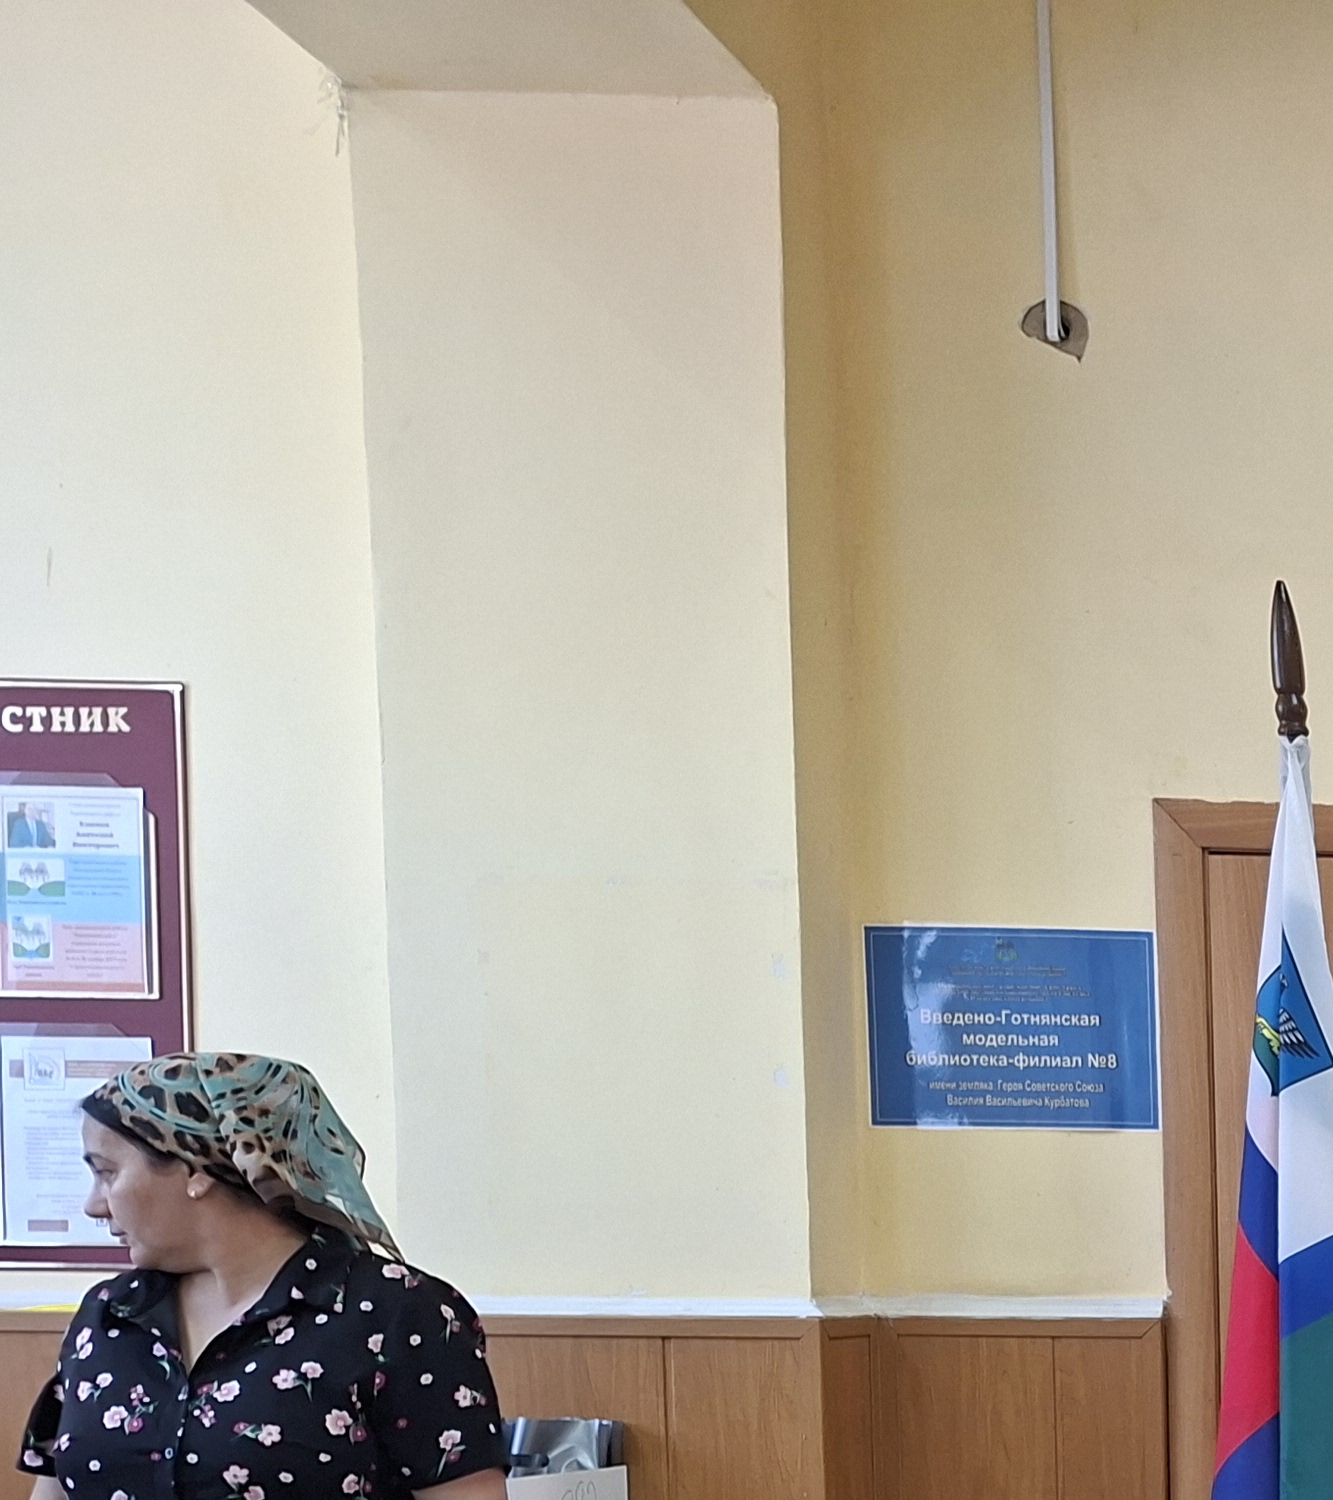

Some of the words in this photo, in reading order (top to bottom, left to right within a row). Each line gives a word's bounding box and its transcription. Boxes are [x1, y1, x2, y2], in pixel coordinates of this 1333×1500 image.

[919, 1008, 1101, 1028] Введено-Готнянская
[962, 1034, 1060, 1048] модельная
[905, 1052, 1083, 1069] библиотека-филиал
[1087, 1053, 1118, 1070] №8
[929, 1080, 957, 1091] имени
[997, 1079, 1023, 1092] Героя
[1024, 1080, 1074, 1092] Советского
[1075, 1081, 1104, 1093] Союза
[946, 1094, 984, 1106] Василия
[985, 1095, 1043, 1107] Васильевича
